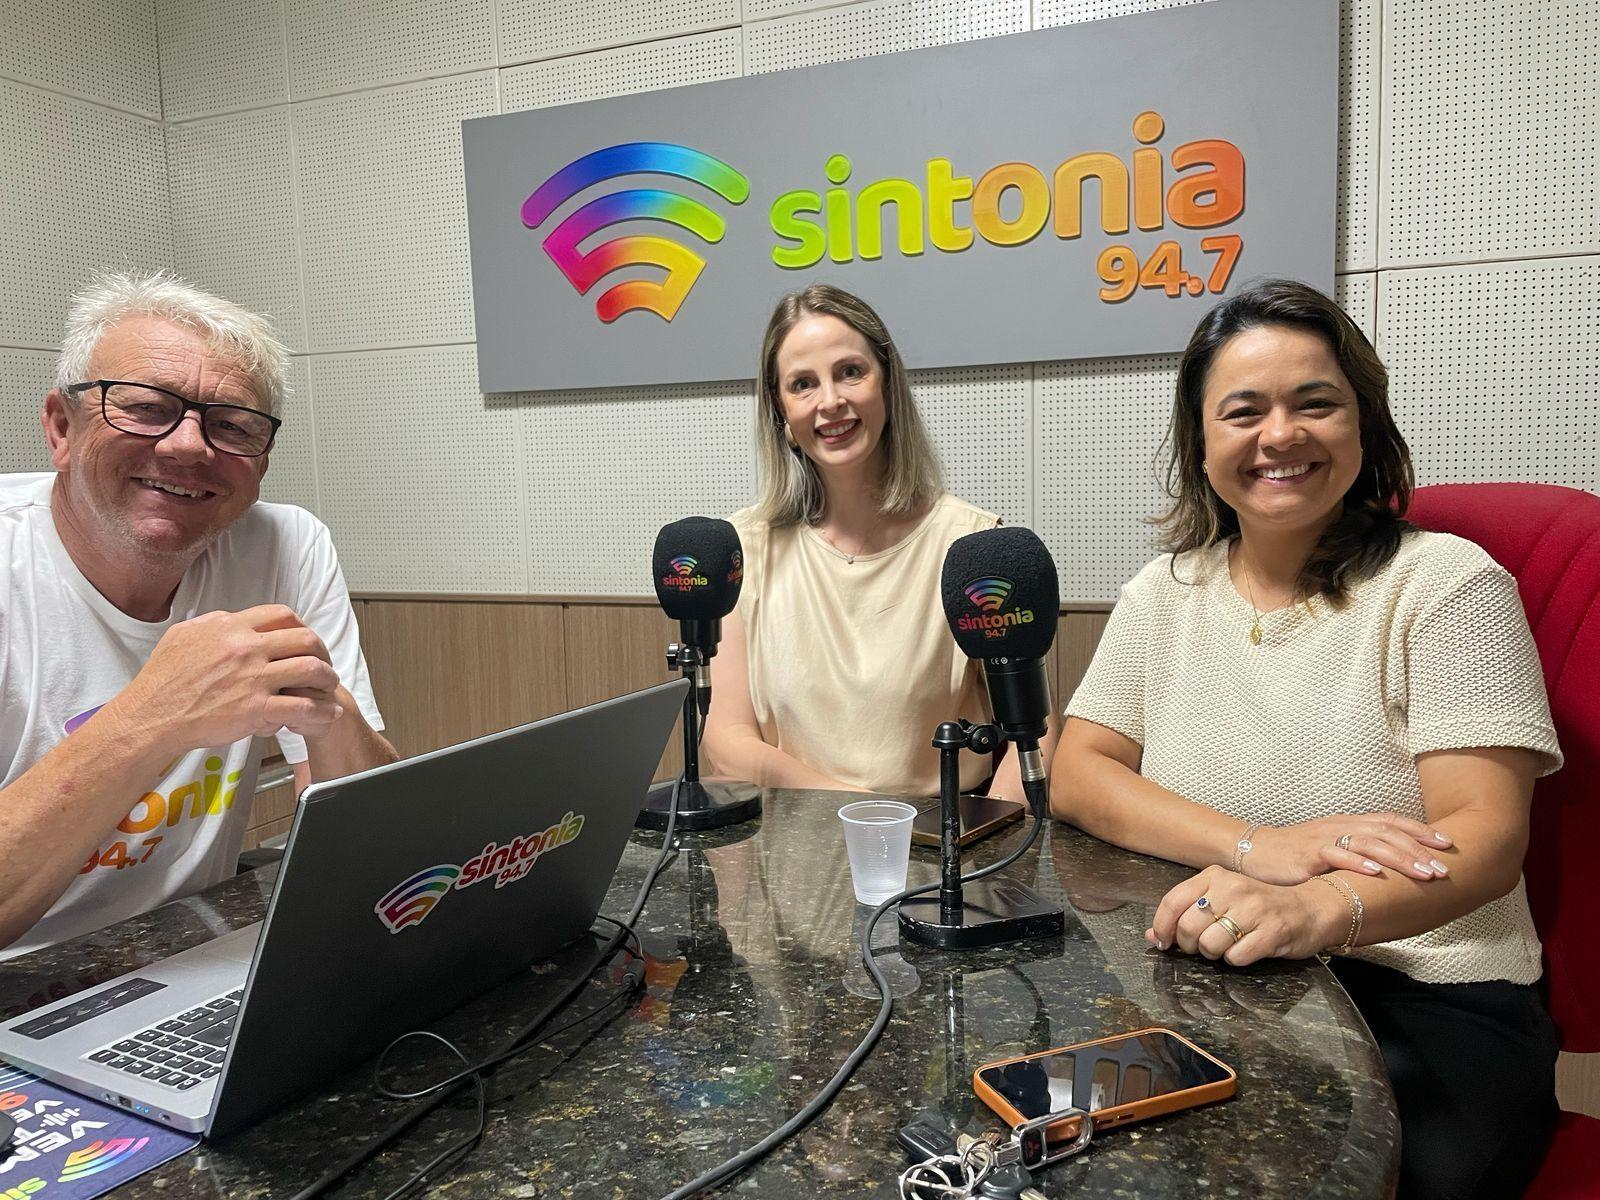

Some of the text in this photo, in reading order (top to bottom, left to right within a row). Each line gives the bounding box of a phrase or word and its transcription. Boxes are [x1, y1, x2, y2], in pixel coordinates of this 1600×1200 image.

[770, 111, 1246, 270] sintonia
[1096, 234, 1244, 303] 94.7
[662, 574, 708, 586] sintonia
[957, 607, 1034, 630] sintonia
[984, 628, 1007, 638] 94.7
[458, 813, 584, 886] sintonia
[498, 858, 534, 885] 94.7
